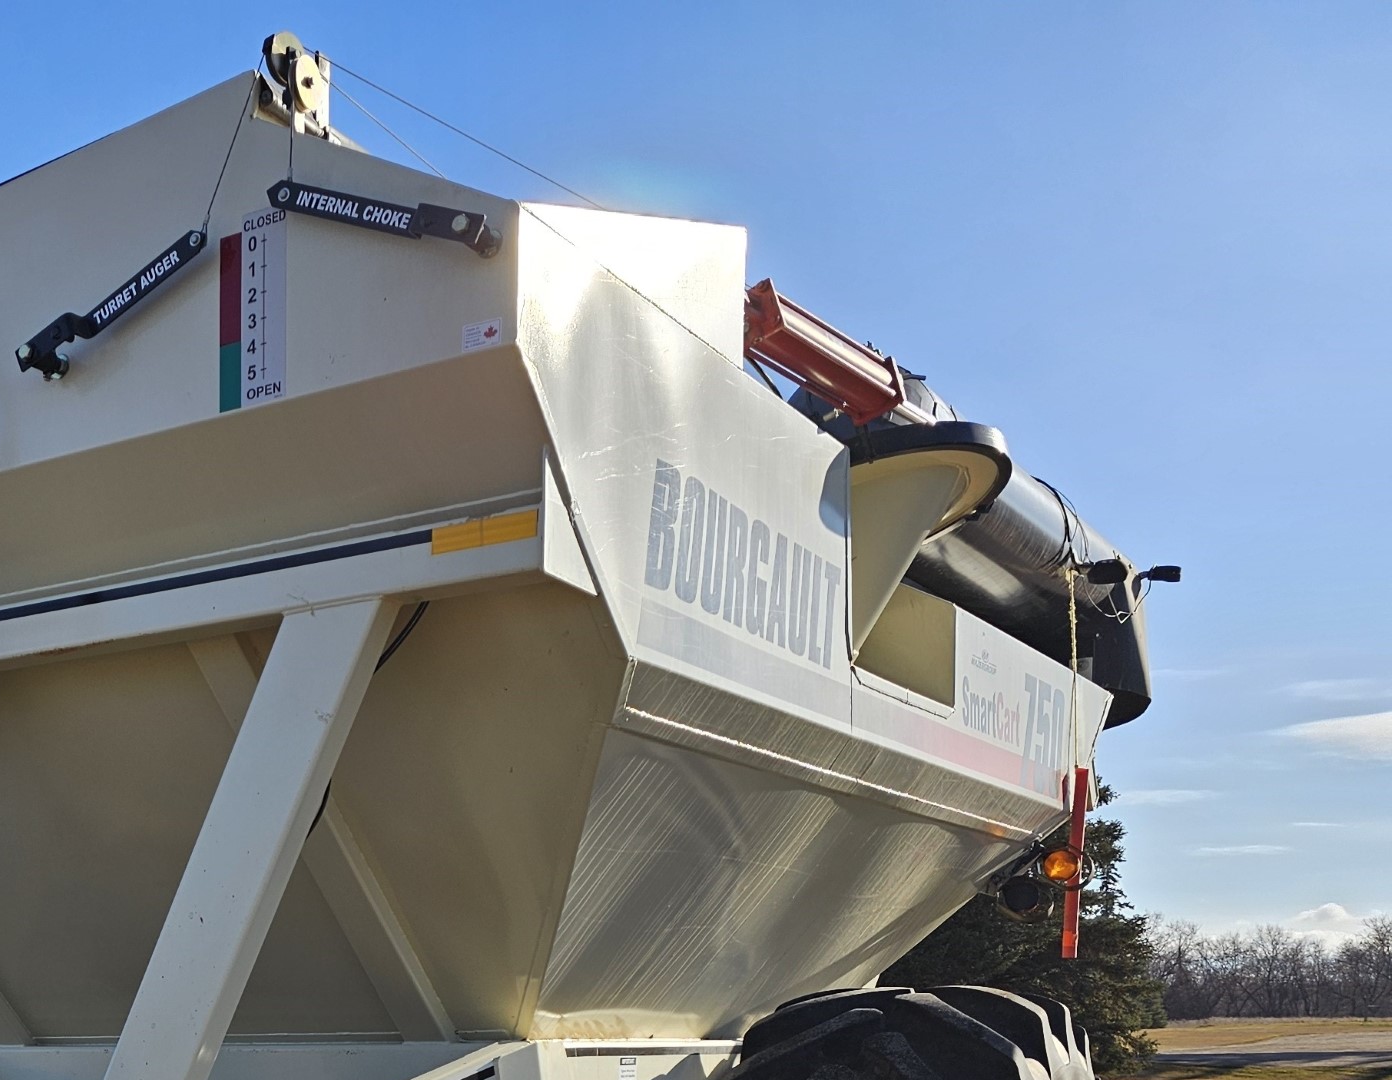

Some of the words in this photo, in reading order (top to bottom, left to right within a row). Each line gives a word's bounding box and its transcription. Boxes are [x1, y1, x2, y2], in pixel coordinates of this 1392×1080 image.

[295, 190, 359, 219] INTERNAL
[362, 205, 411, 230] CHOKE
[243, 209, 286, 233] CLOSED
[248, 236, 257, 252] 0
[248, 263, 256, 277] 1
[93, 282, 137, 325] TURRET
[140, 250, 180, 290] AUGER
[248, 288, 257, 304] 2
[248, 313, 257, 329] 3
[247, 339, 256, 355] 4
[247, 364, 256, 381] 5
[246, 381, 281, 400] OPEN
[644, 458, 841, 670] BOURGAULT
[962, 675, 1020, 747] SmartCart
[1020, 673, 1065, 799] 750
